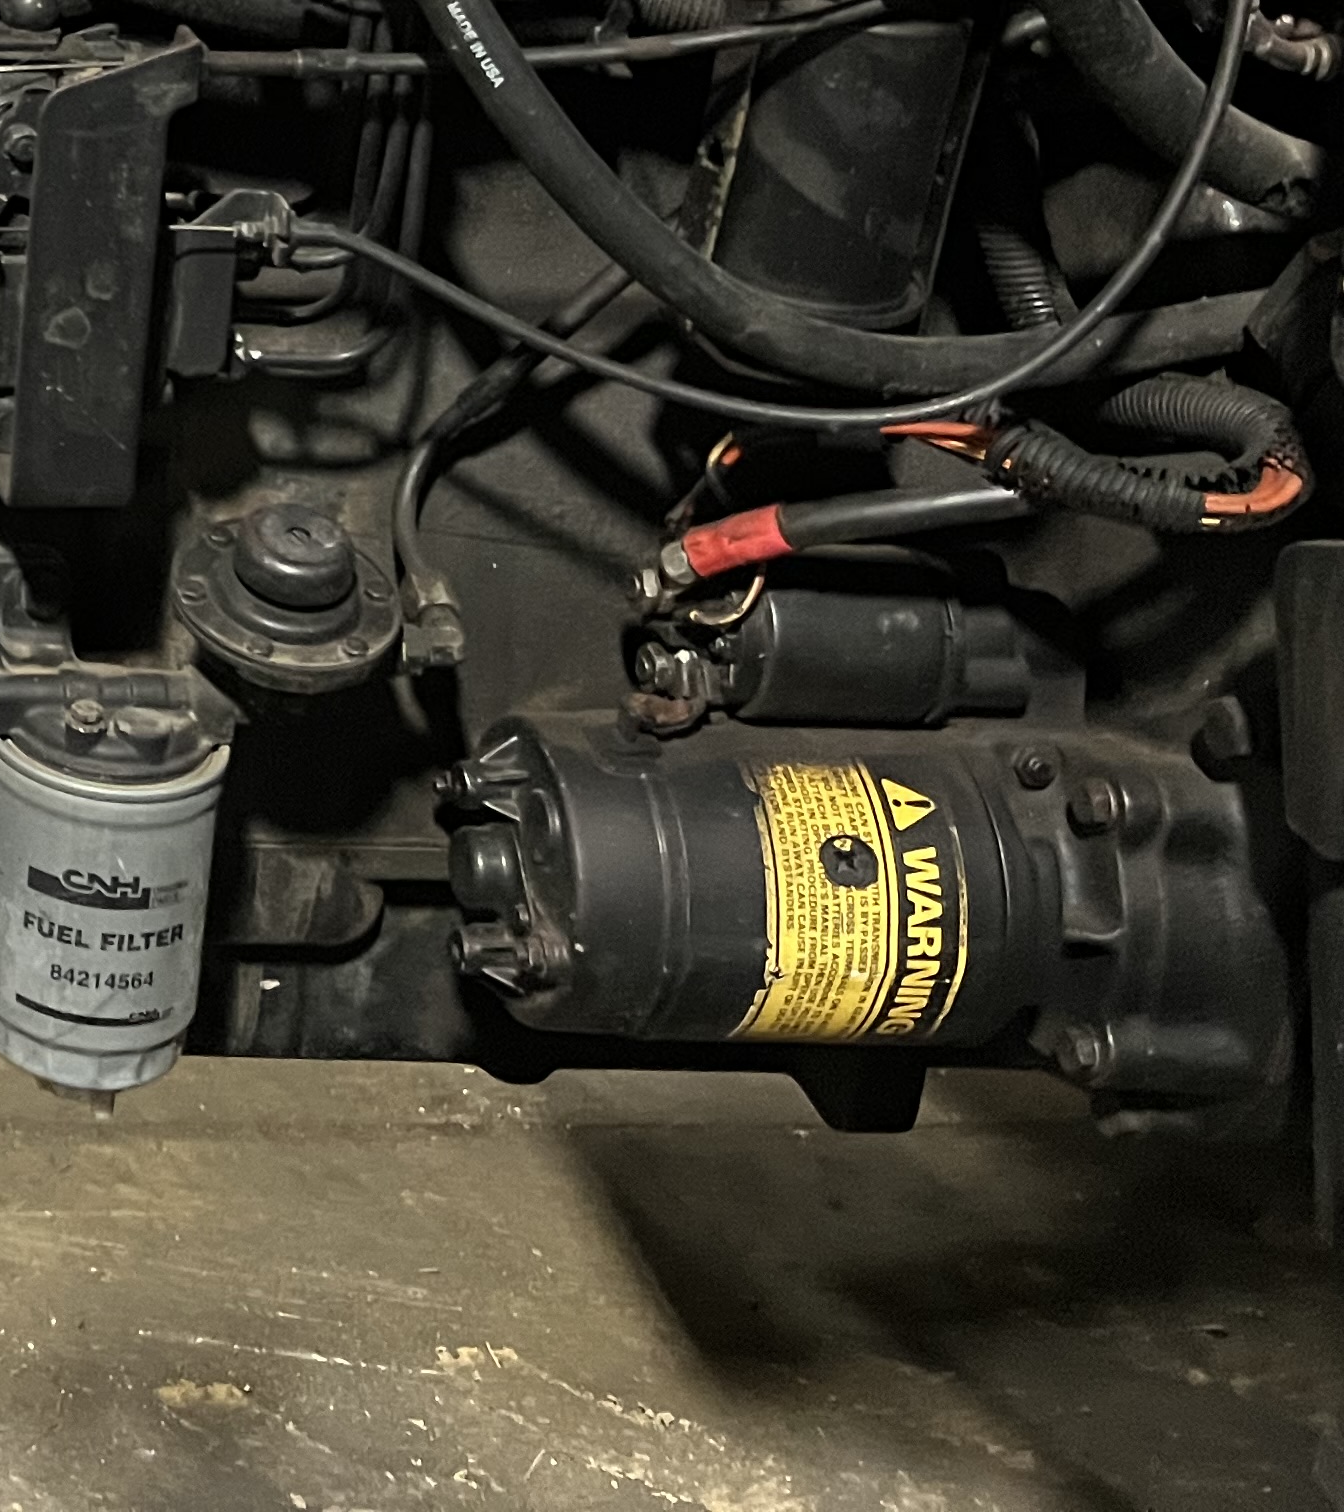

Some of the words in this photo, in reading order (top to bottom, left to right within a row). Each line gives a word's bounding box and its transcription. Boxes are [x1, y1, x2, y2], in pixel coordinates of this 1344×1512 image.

[447, 0, 479, 41] MADE
[470, 41, 488, 58] IN
[480, 57, 505, 89] USA
[807, 776, 828, 819] ATTACH
[856, 802, 869, 827] CAN
[775, 819, 787, 844] AND
[785, 812, 798, 836] RUN
[792, 797, 812, 854] STARTING
[791, 841, 804, 878] AWAY
[828, 796, 842, 818] NOT
[846, 888, 854, 935] ACROSS
[62, 869, 140, 895] CNH
[797, 883, 806, 909] CAN
[806, 859, 817, 932] PROCEDURE
[807, 808, 816, 819] IN
[820, 904, 829, 956] MANUAL
[860, 896, 869, 907] IS
[23, 910, 90, 949] FUEL
[100, 923, 183, 951] FILTER
[797, 914, 806, 953] CAUSE
[876, 845, 943, 1035] WARNING
[808, 937, 817, 969] FROM
[50, 964, 154, 989] 84214564
